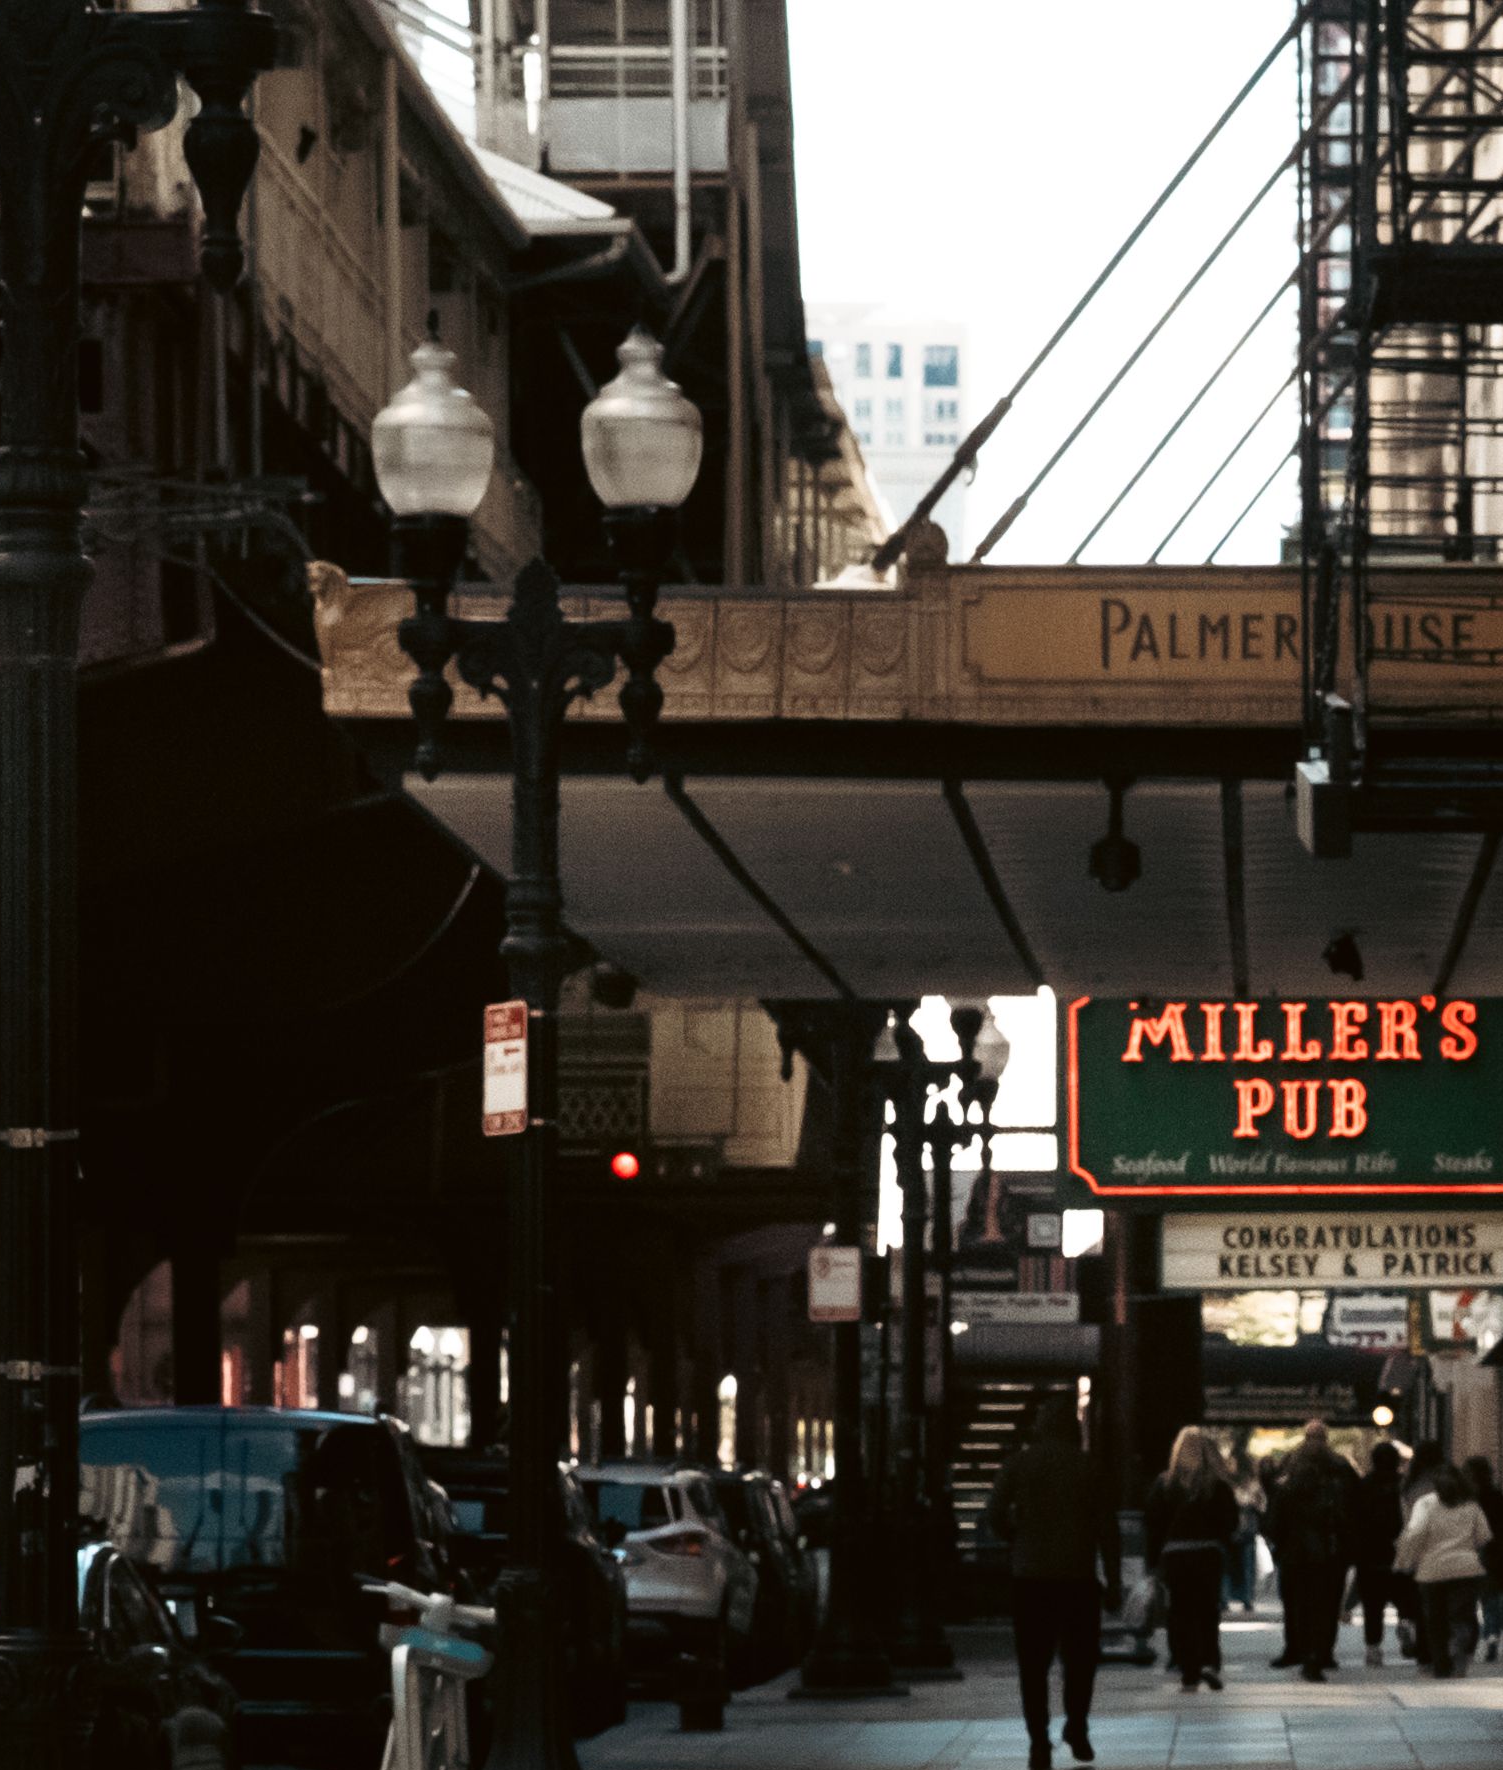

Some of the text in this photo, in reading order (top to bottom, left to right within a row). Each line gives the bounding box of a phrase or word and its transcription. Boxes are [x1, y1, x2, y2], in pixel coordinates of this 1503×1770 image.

[1101, 599, 1298, 671] PALMER
[1120, 995, 1480, 1063] MILLER'S
[1232, 1077, 1369, 1140] PUB
[1217, 1251, 1495, 1279] KELSEY & PATRICK
[1222, 1224, 1477, 1249] CONGRATULATIONS
